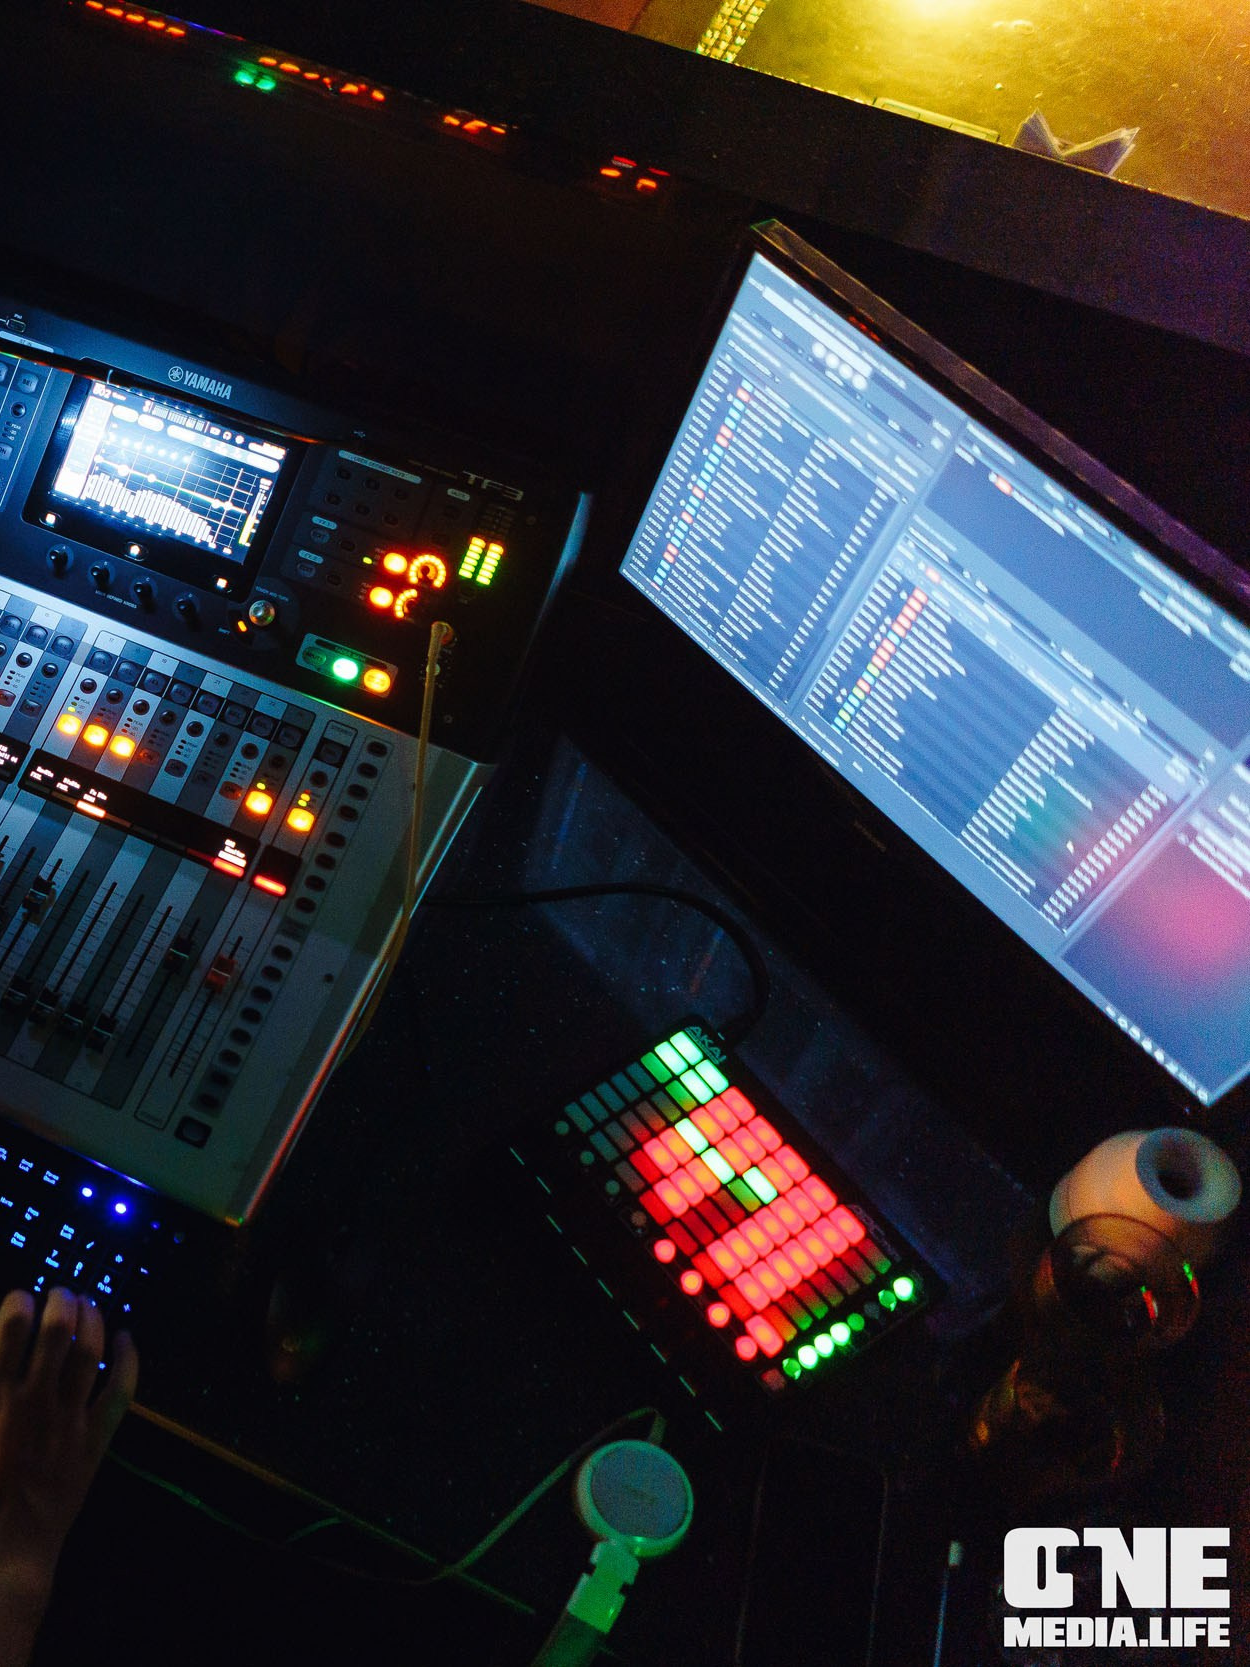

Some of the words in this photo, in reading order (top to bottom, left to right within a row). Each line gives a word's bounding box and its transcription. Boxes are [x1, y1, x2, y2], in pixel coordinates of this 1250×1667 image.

[182, 370, 232, 400] YAMAHA
[463, 471, 523, 501] TF3
[688, 1026, 727, 1061] AKAI
